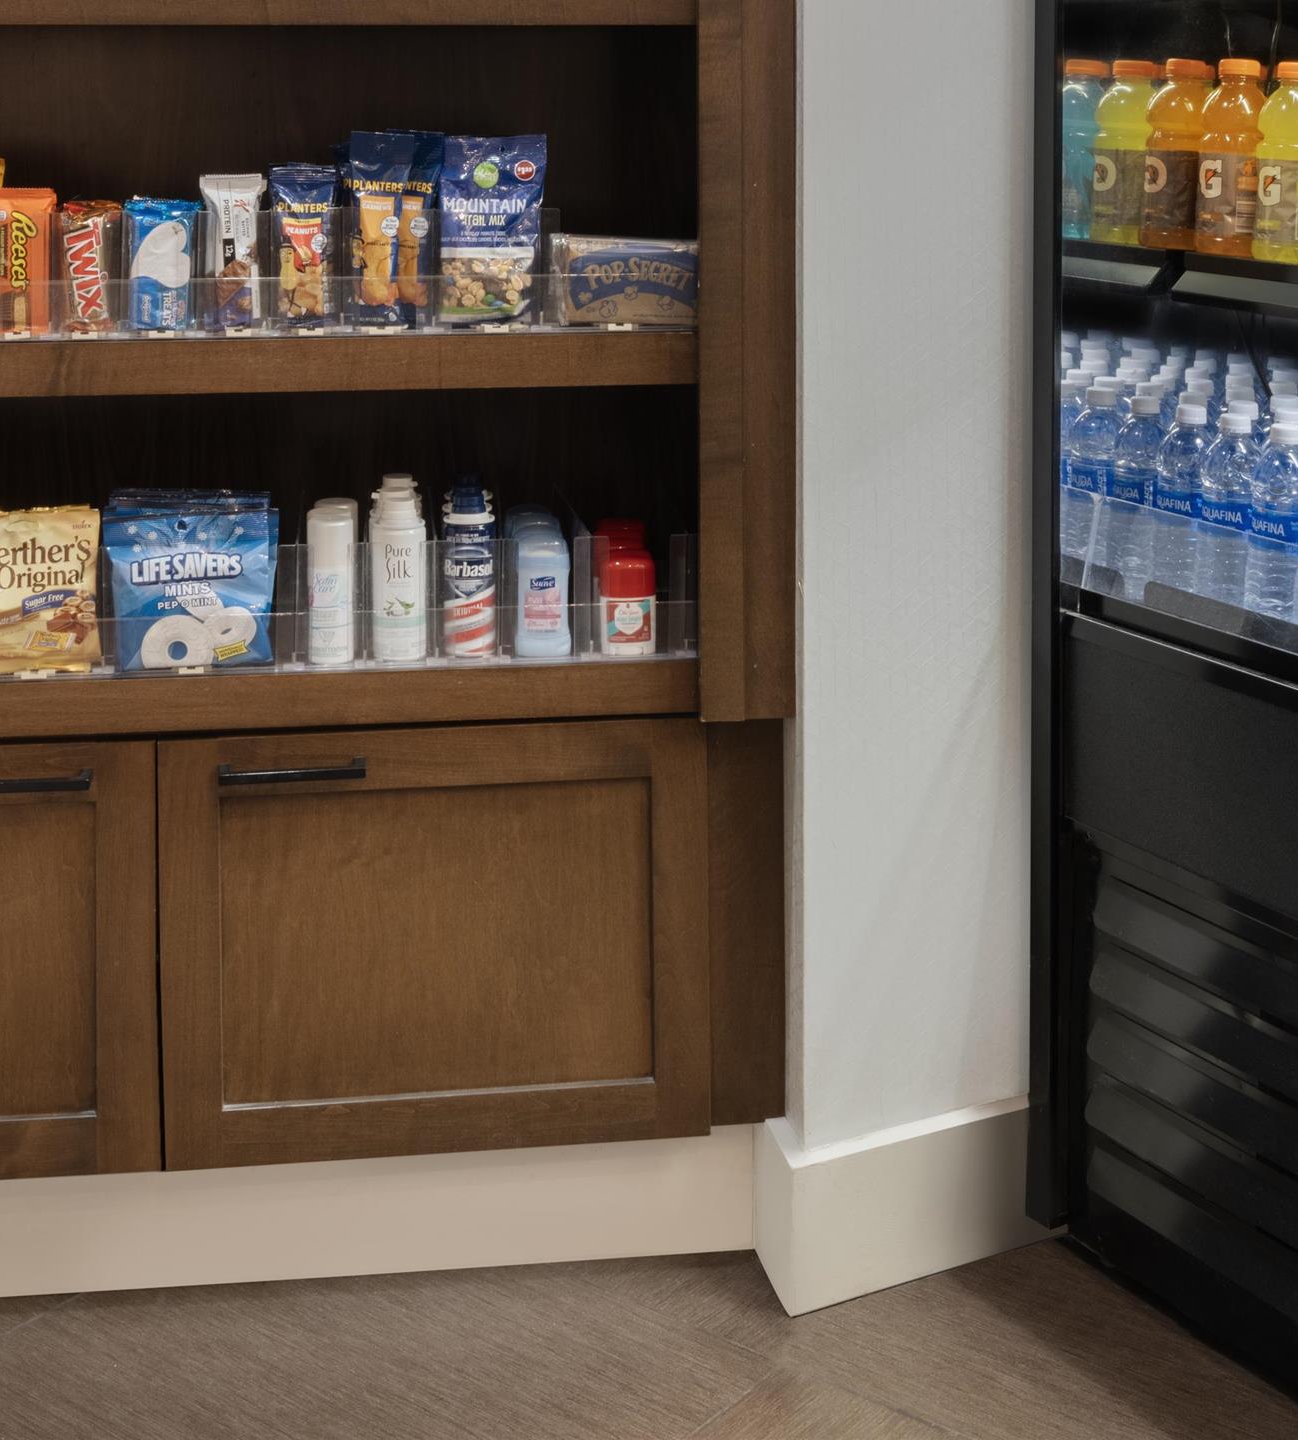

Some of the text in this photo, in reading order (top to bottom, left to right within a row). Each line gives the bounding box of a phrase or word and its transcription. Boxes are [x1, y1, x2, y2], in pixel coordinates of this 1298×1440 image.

[353, 179, 403, 193] PLANTERS
[1199, 160, 1222, 199] G
[1258, 165, 1281, 207] G
[277, 201, 328, 214] PLANTERS
[443, 197, 527, 214] MOUNTAIN
[222, 199, 231, 234] PROTEIN
[488, 213, 506, 226] MIX
[285, 224, 319, 234] PEANUTS
[63, 215, 104, 319] TWIX
[161, 292, 171, 326] TREATS
[385, 543, 412, 558] Pure
[131, 552, 243, 584] LIFE SAVERS
[385, 559, 411, 583] Silk
[444, 560, 493, 577] Barbasol
[165, 582, 211, 598] MINTS
[24, 593, 65, 609] Sugar Free
[157, 597, 219, 610] PEP MINT
